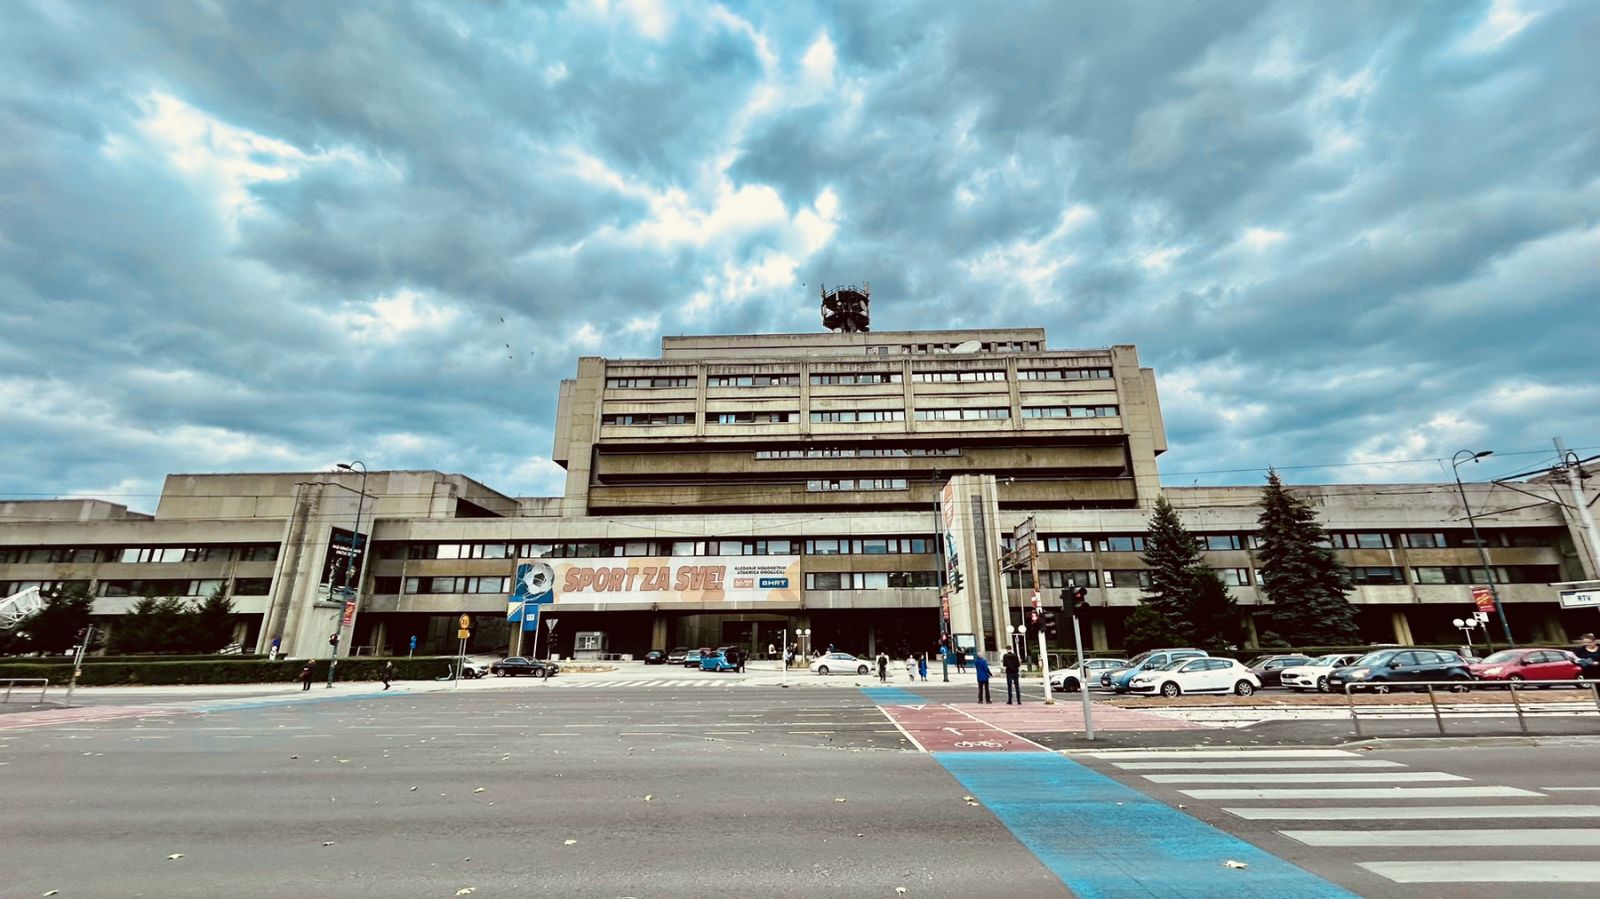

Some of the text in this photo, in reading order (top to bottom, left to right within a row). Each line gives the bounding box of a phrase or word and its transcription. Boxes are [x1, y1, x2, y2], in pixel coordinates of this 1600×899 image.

[563, 566, 726, 592] SPORT ZA SVE!
